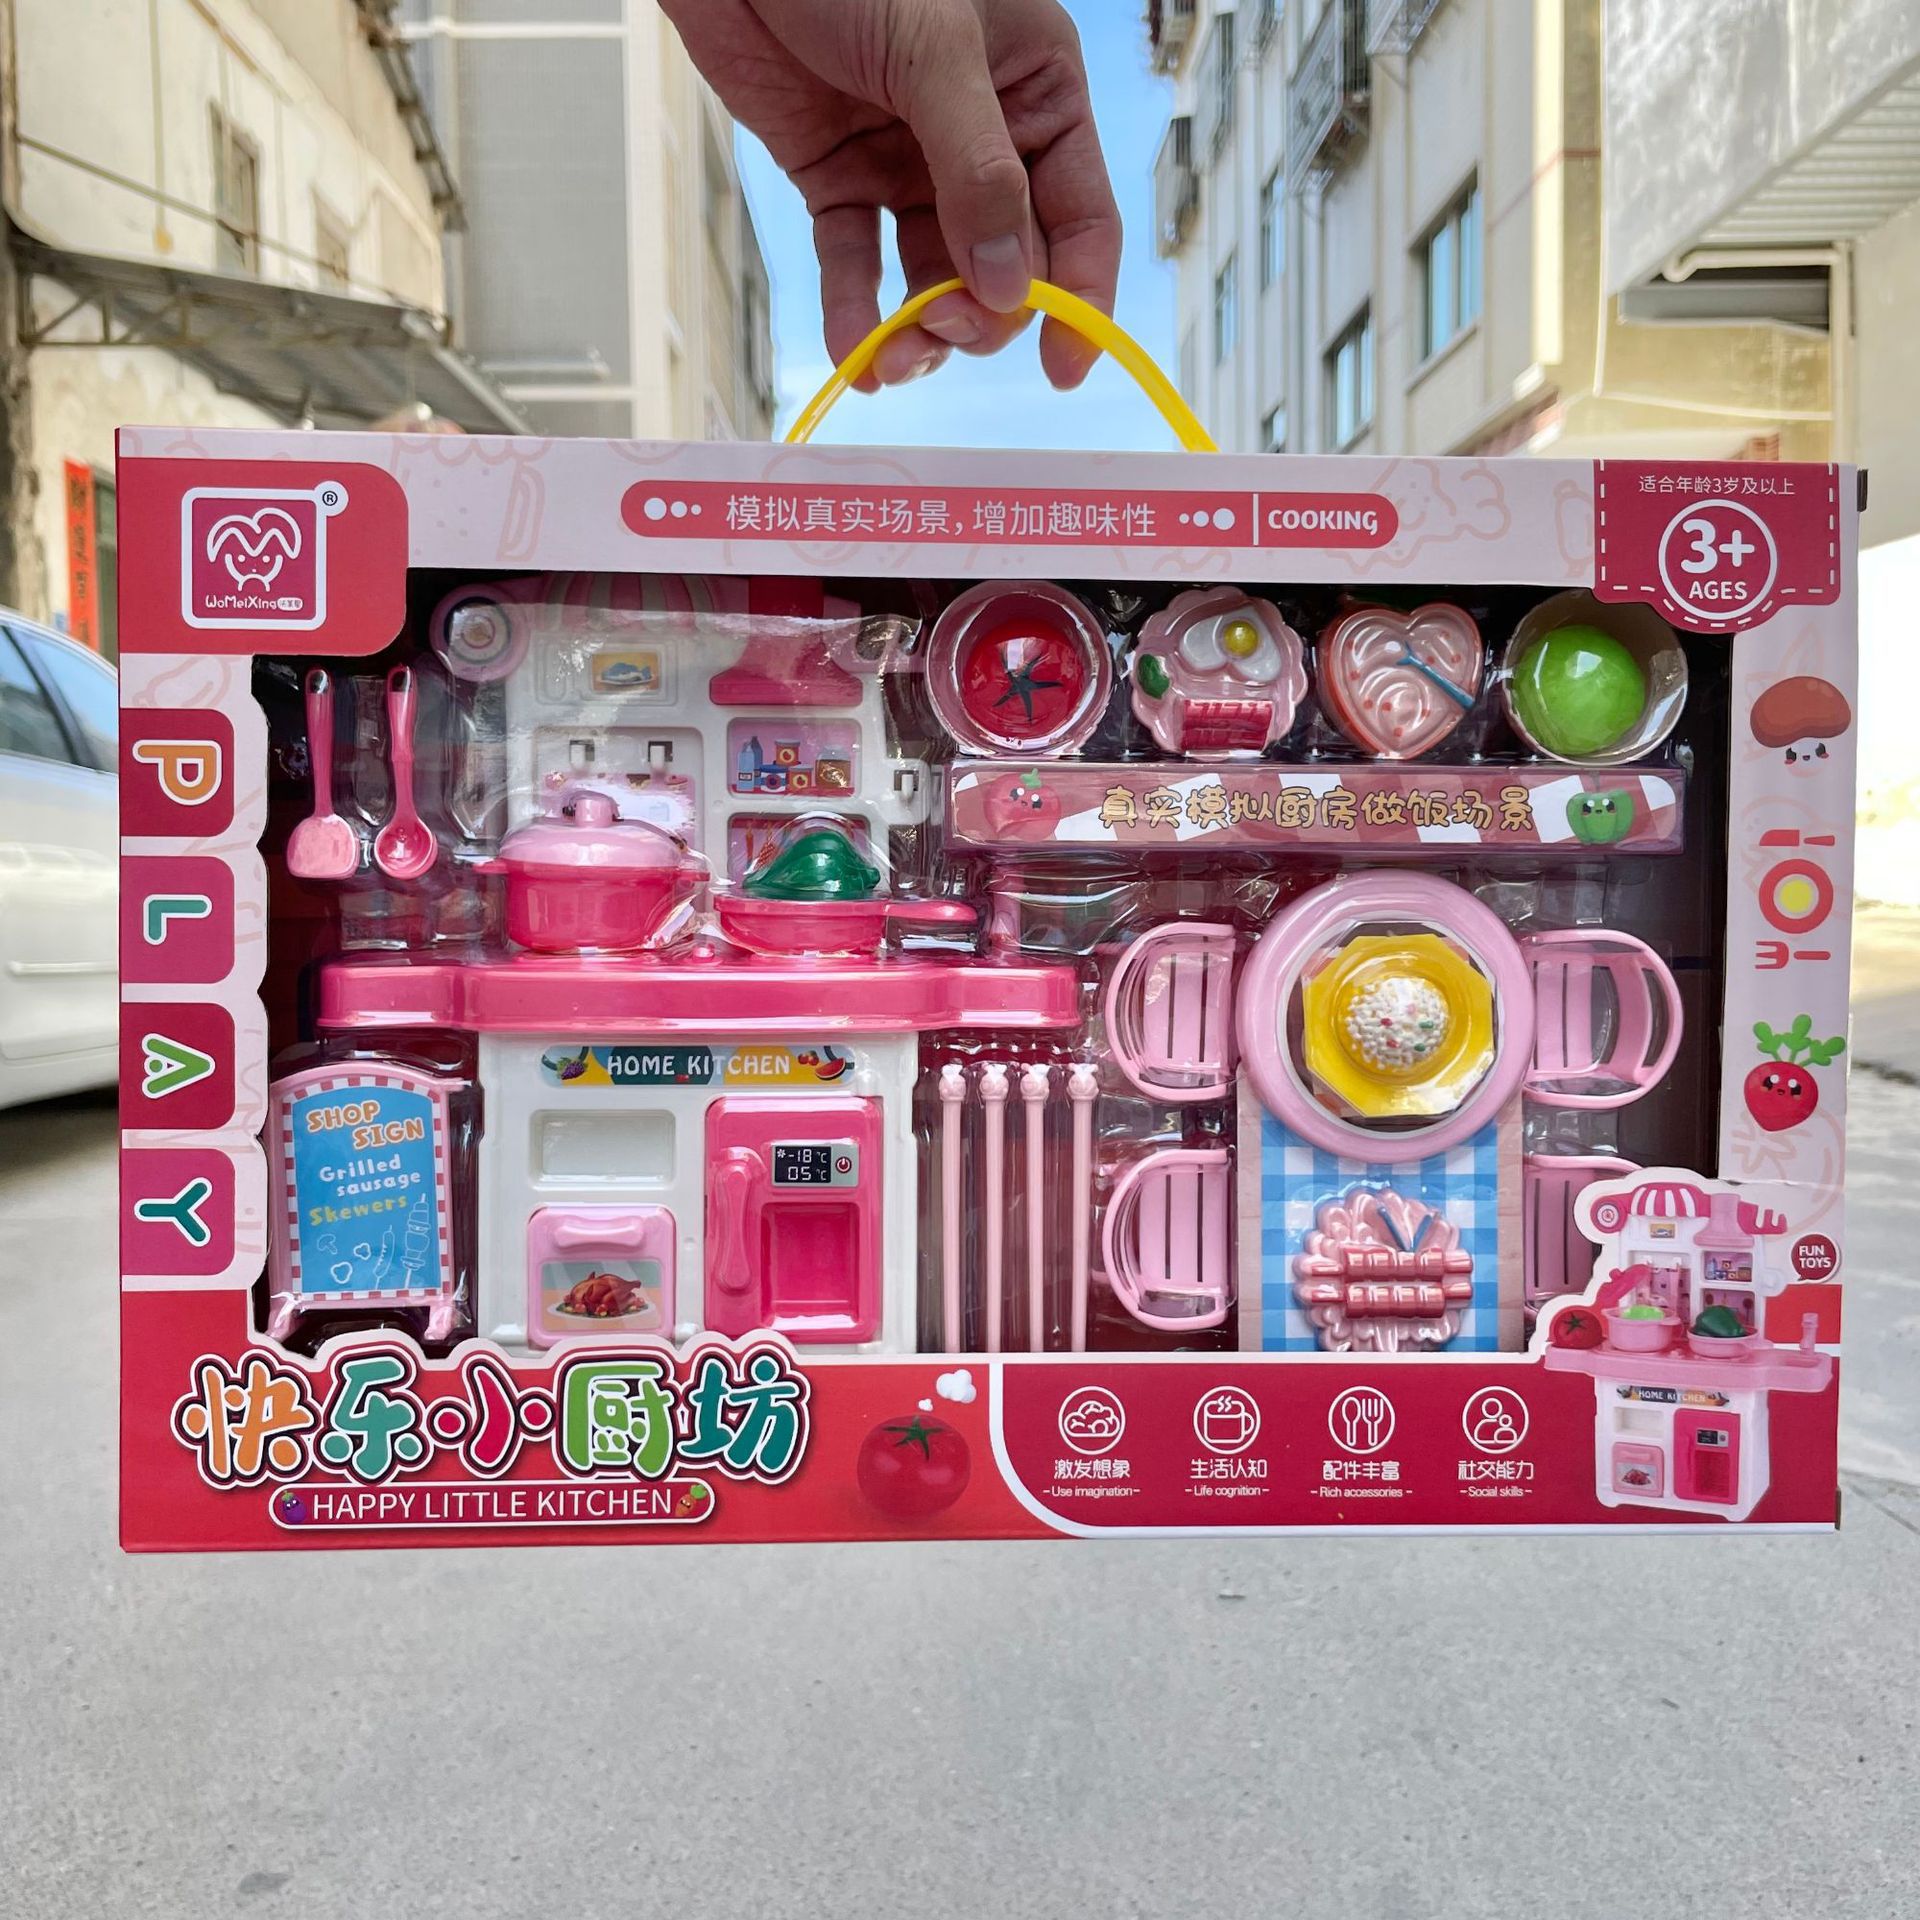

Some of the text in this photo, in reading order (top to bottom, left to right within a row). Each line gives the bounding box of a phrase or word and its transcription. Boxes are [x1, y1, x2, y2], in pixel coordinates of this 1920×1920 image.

[1639, 475, 1796, 495] 适合年龄3岁及以上
[1267, 509, 1378, 535] COOKING
[1680, 518, 1755, 574] 3+
[1688, 580, 1748, 600] AGES
[205, 595, 278, 610] WoMeiXing
[1099, 785, 1534, 832] 真实模拟厨房做饭场景
[607, 1055, 791, 1077] HOME KITCHEN
[305, 1100, 381, 1133] SHOP
[353, 1117, 426, 1150] SIGN
[319, 1153, 402, 1182] Grilled
[336, 1170, 422, 1197] sausage
[309, 1196, 408, 1227] Skewers
[1799, 1244, 1825, 1257] FUN
[1799, 1257, 1832, 1269] TOYS
[1638, 1390, 1664, 1401] HOME
[179, 1351, 804, 1481] 快乐小厨坊
[1053, 1458, 1131, 1480] 激发想象
[1189, 1458, 1269, 1479] 生活认知
[1322, 1460, 1401, 1481] 配件丰富
[1457, 1460, 1534, 1481] 社交能力
[312, 1488, 672, 1520] HAPPY LITTLE KITCHEN
